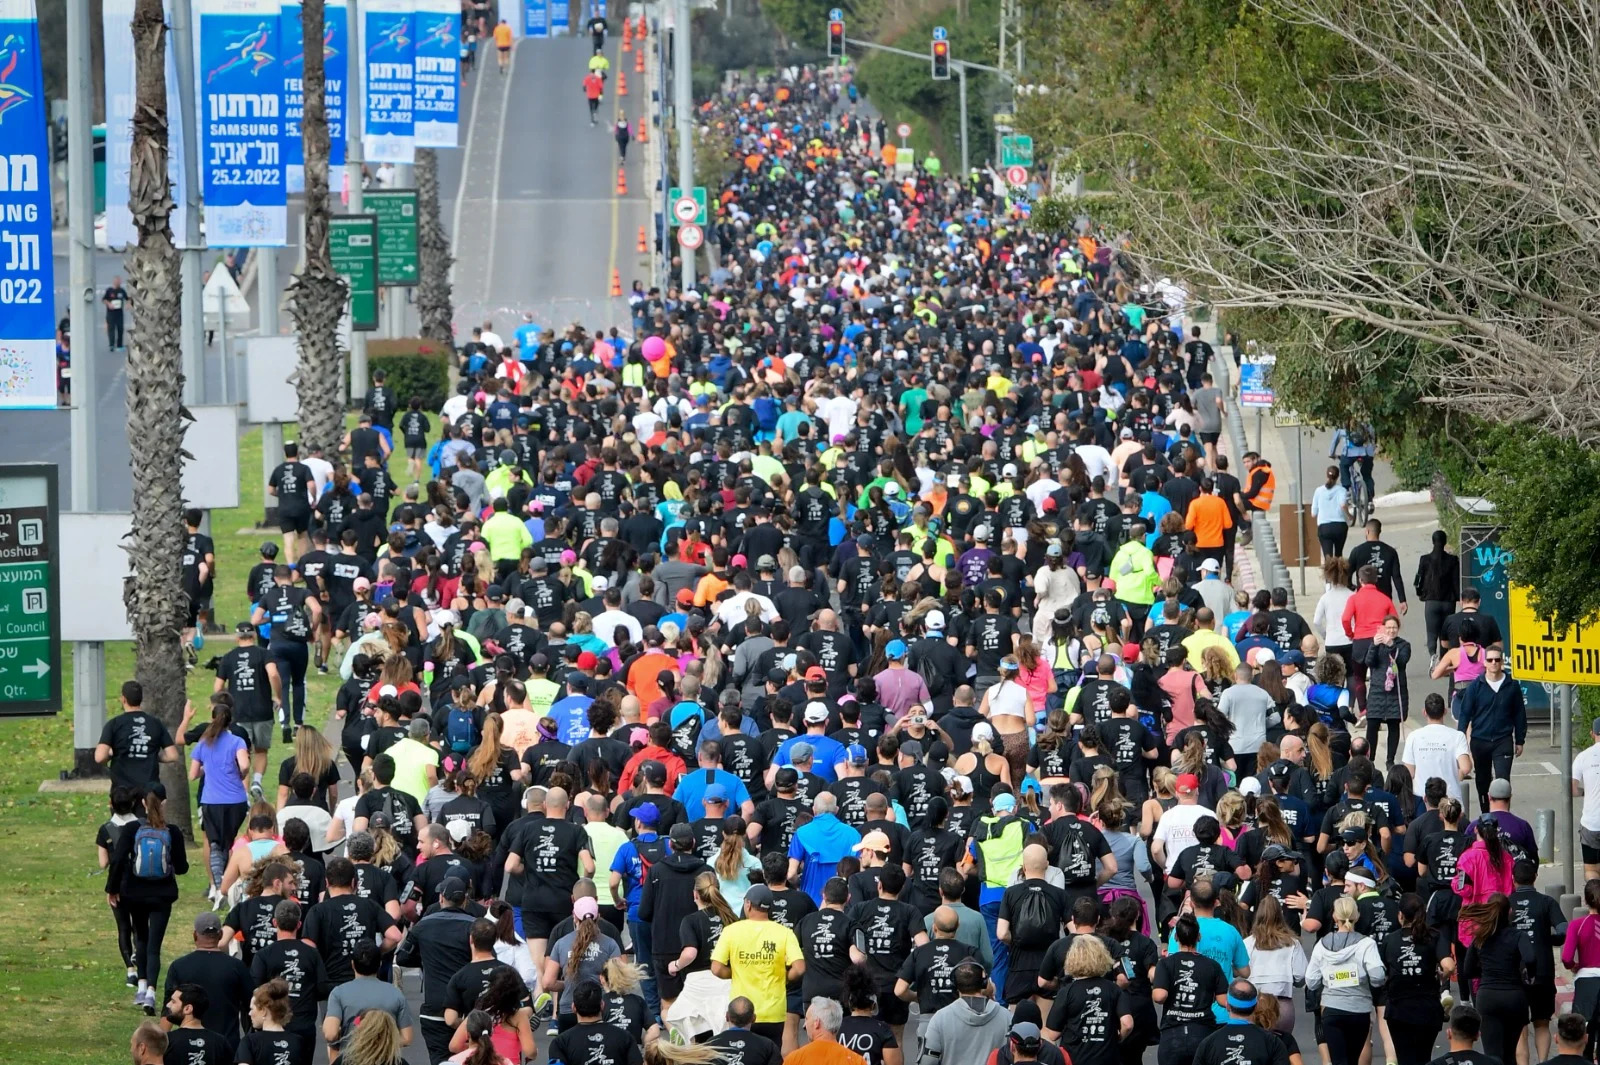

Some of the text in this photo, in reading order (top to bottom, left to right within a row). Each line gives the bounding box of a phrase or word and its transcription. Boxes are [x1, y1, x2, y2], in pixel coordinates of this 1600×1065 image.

[208, 94, 279, 121] מרתון
[210, 124, 278, 135] SAMSUNG
[212, 169, 280, 185] 25.2.2022
[6, 621, 45, 634] Council
[1516, 644, 1563, 672] ימינה
[4, 684, 27, 698] Qtr.
[739, 951, 774, 960] EzeRun
